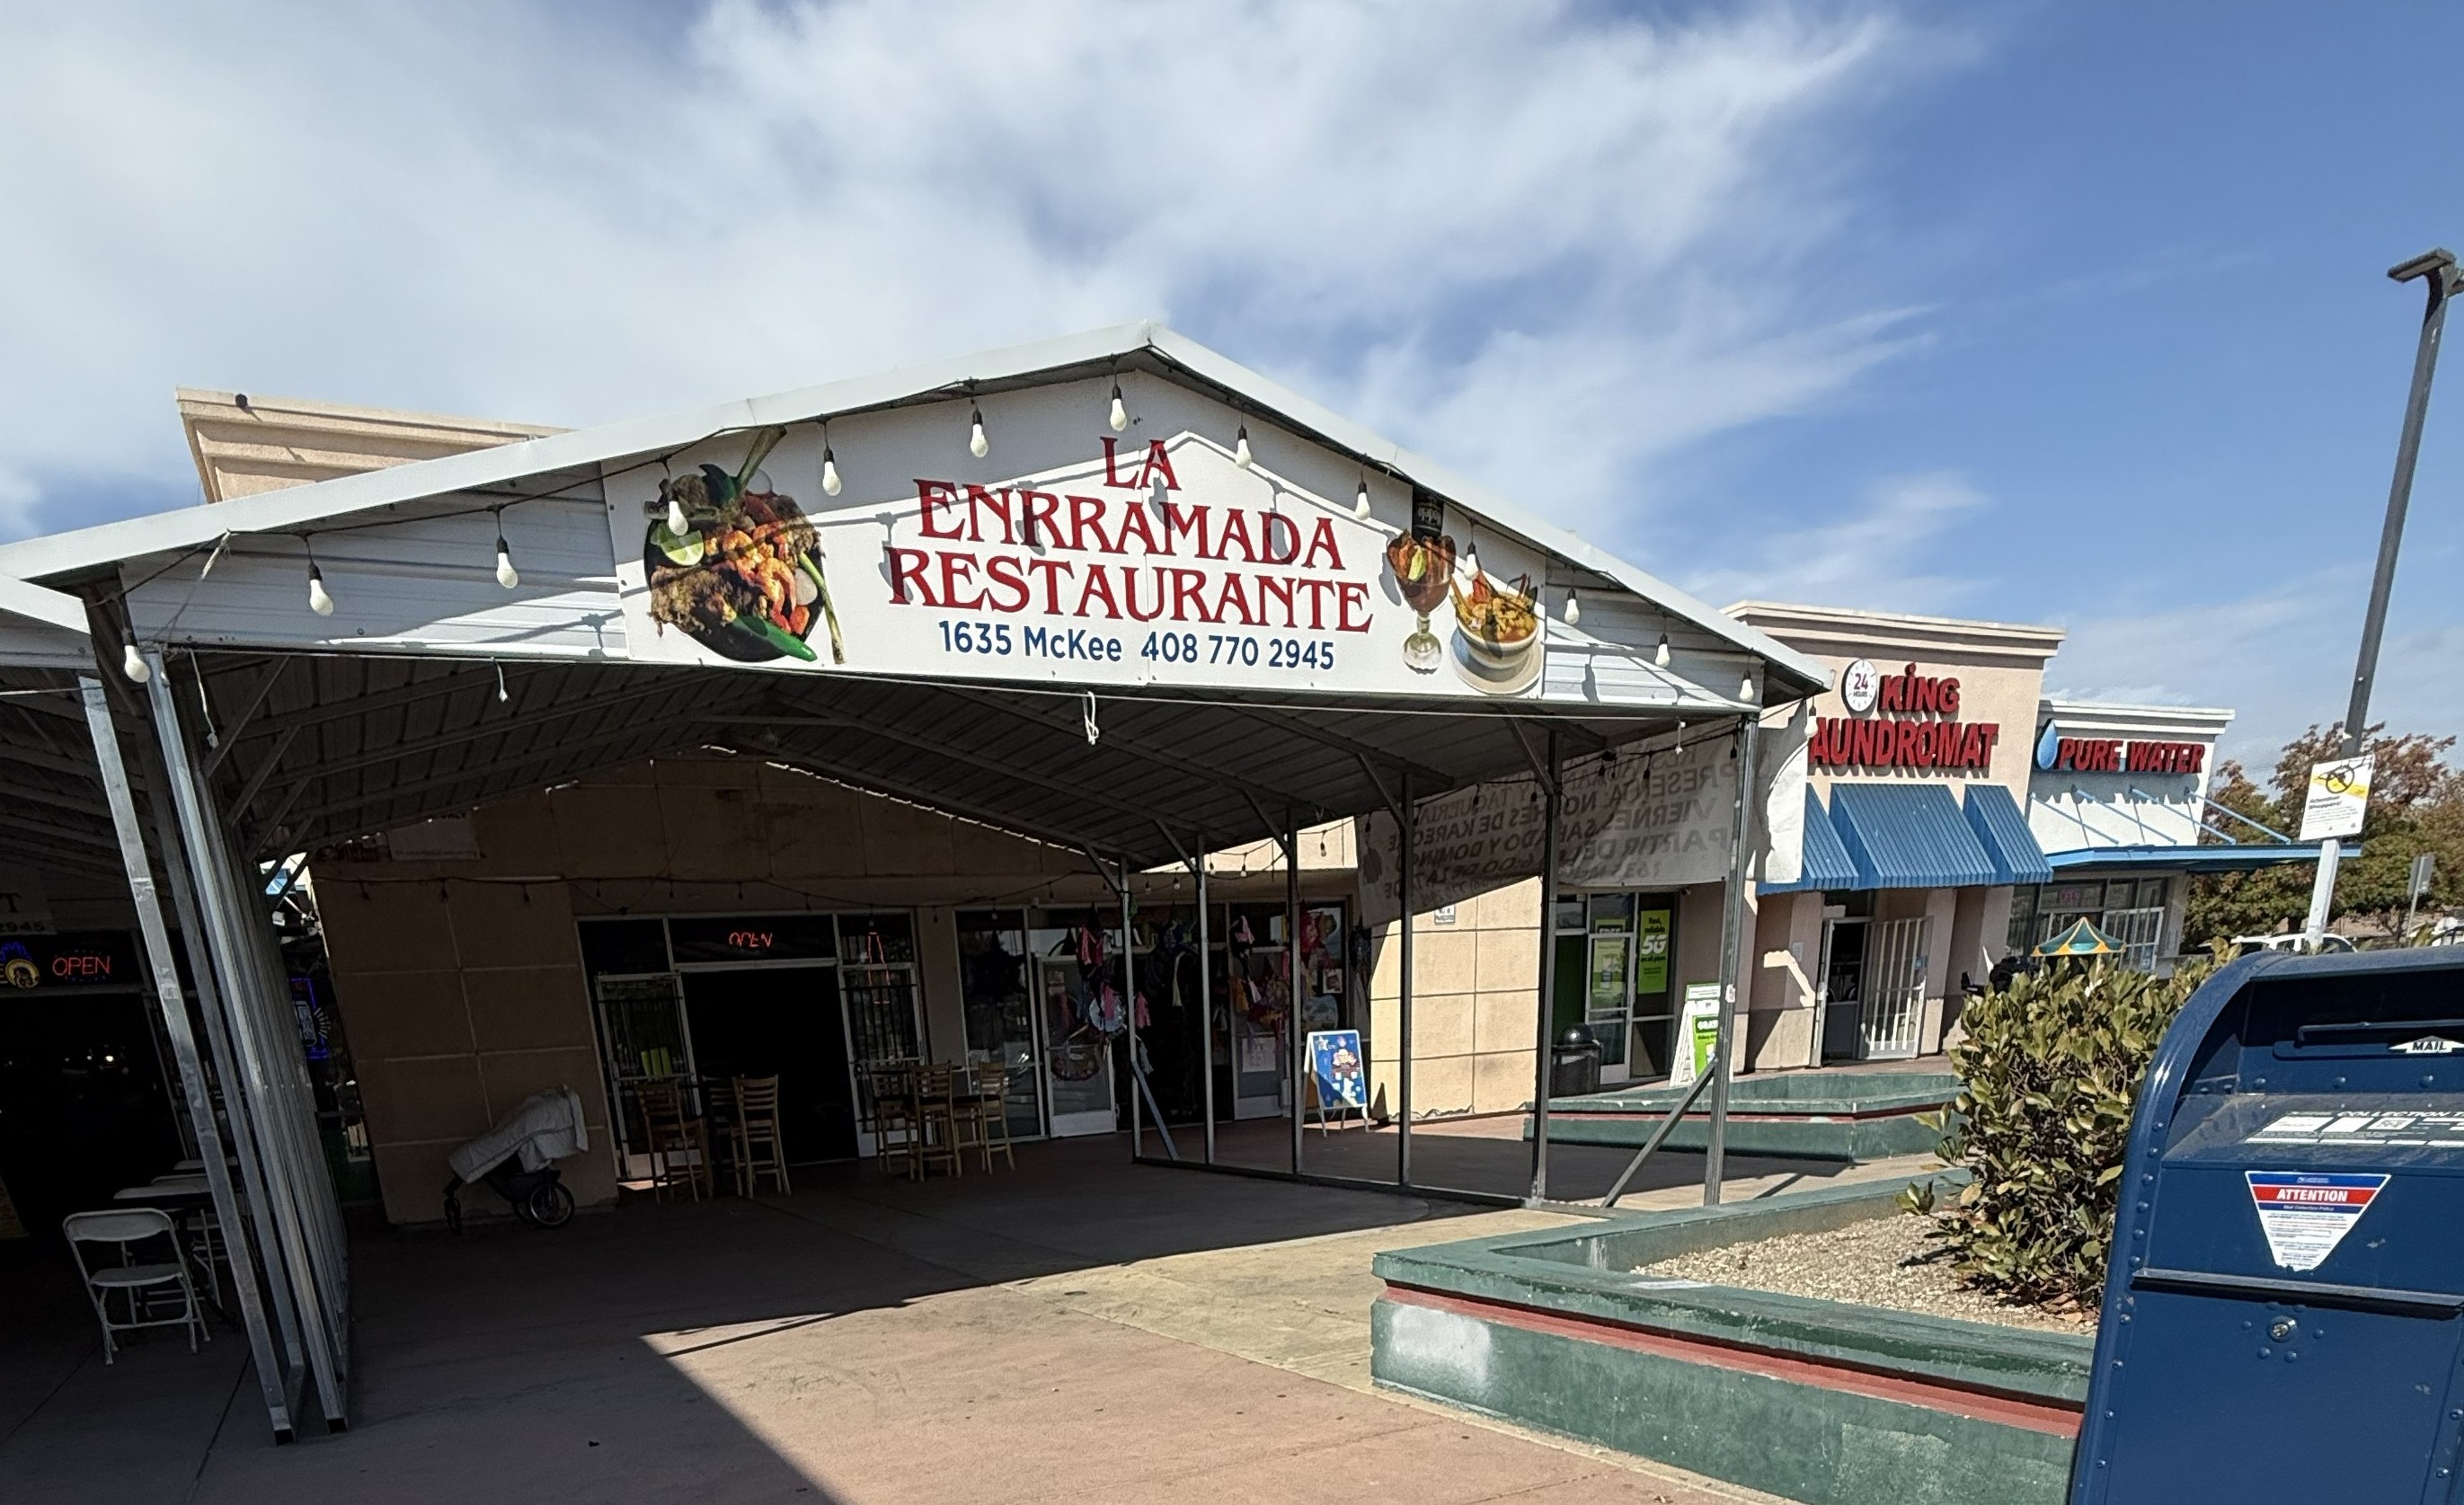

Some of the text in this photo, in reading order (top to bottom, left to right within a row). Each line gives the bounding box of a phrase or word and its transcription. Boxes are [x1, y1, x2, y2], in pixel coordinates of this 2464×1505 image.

[1100, 436, 1182, 491] LA
[913, 478, 1346, 571] ENRRAMADA
[884, 546, 1374, 634] RESTAURANTE
[939, 620, 1334, 670] 1635 McKee 408 770 2945
[1853, 672, 1869, 690] 24
[1808, 716, 1999, 767] AUNDROMAT
[2058, 737, 2206, 774] PURE WATER
[1641, 934, 1667, 955] 5G
[52, 955, 111, 977] OPEN
[2412, 1040, 2447, 1052] MAIL
[2276, 1188, 2348, 1202] ATTENTION
